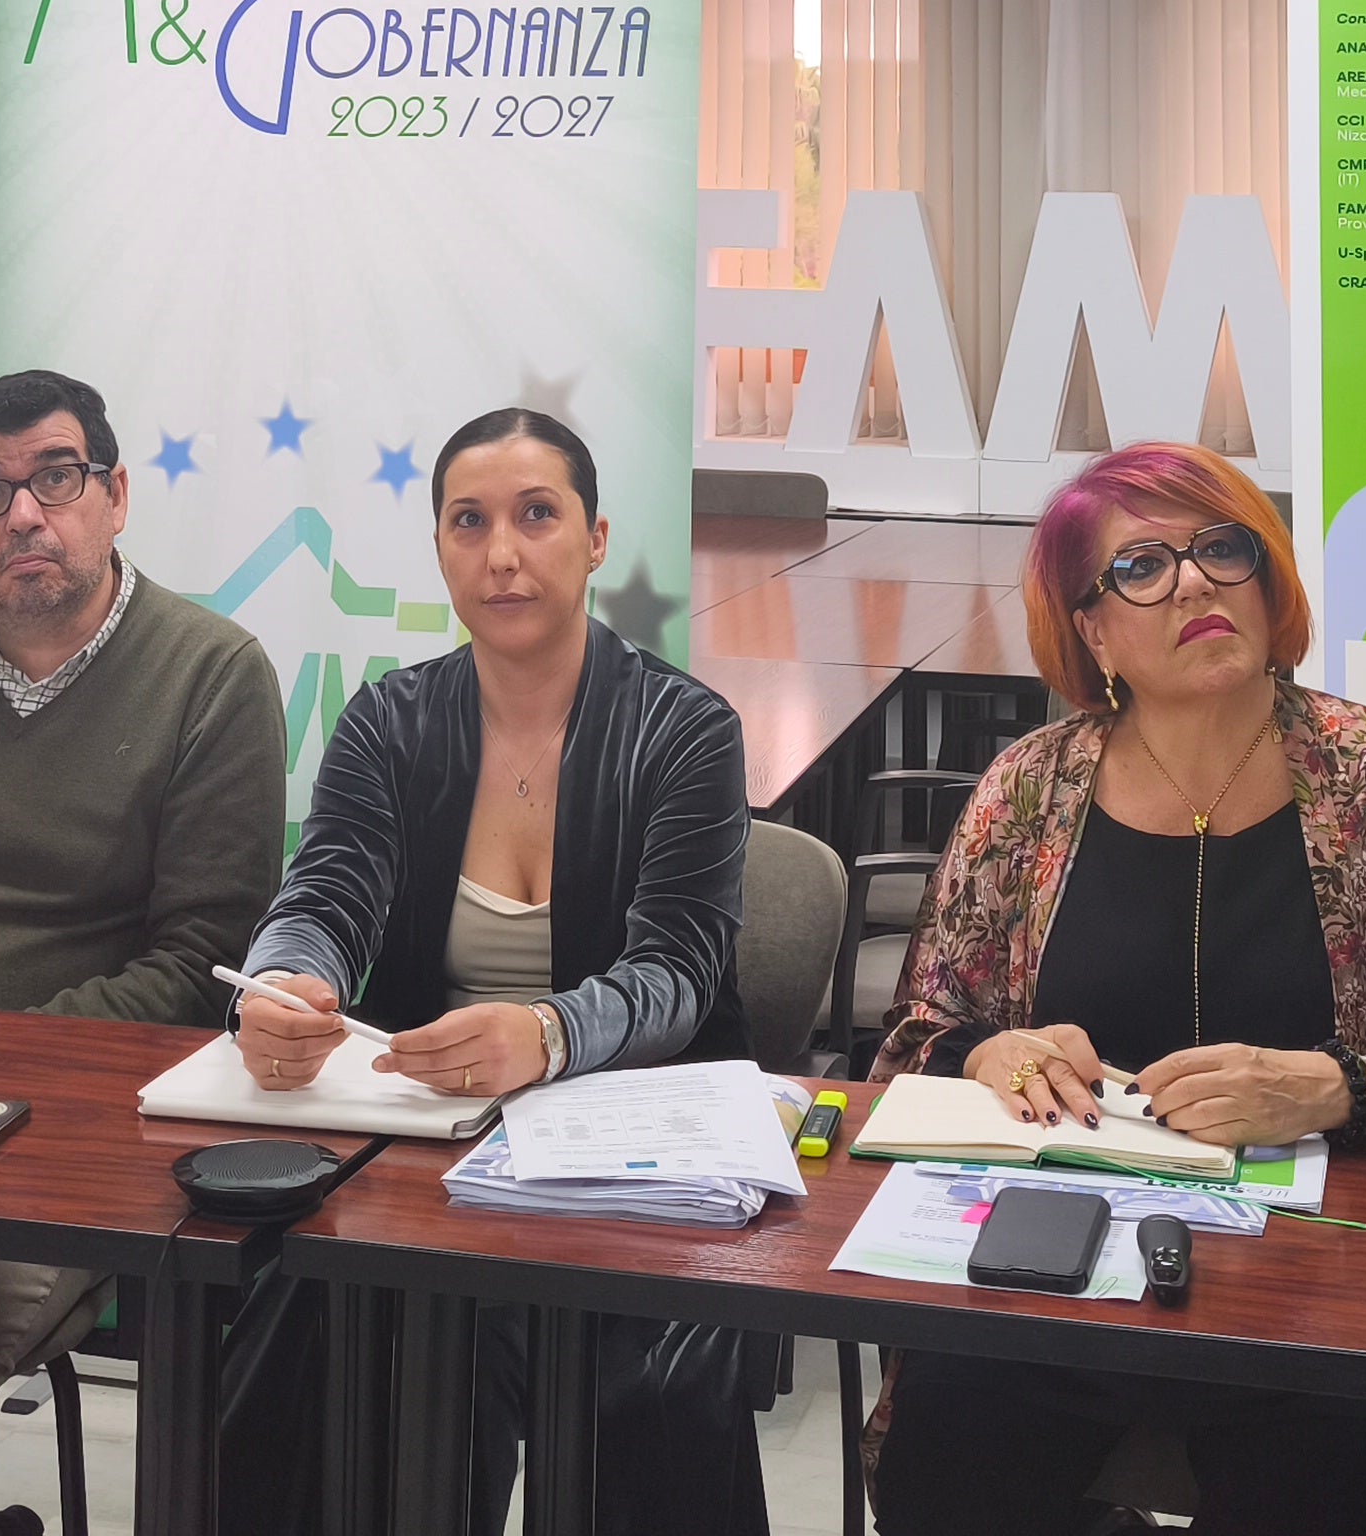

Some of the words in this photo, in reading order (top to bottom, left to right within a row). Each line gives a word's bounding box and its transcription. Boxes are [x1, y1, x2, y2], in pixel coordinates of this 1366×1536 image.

[327, 95, 448, 138] 2023
[459, 97, 480, 138] /
[491, 95, 614, 138] 2027
[1337, 116, 1364, 125] CCI
[1339, 173, 1359, 186] (IT)
